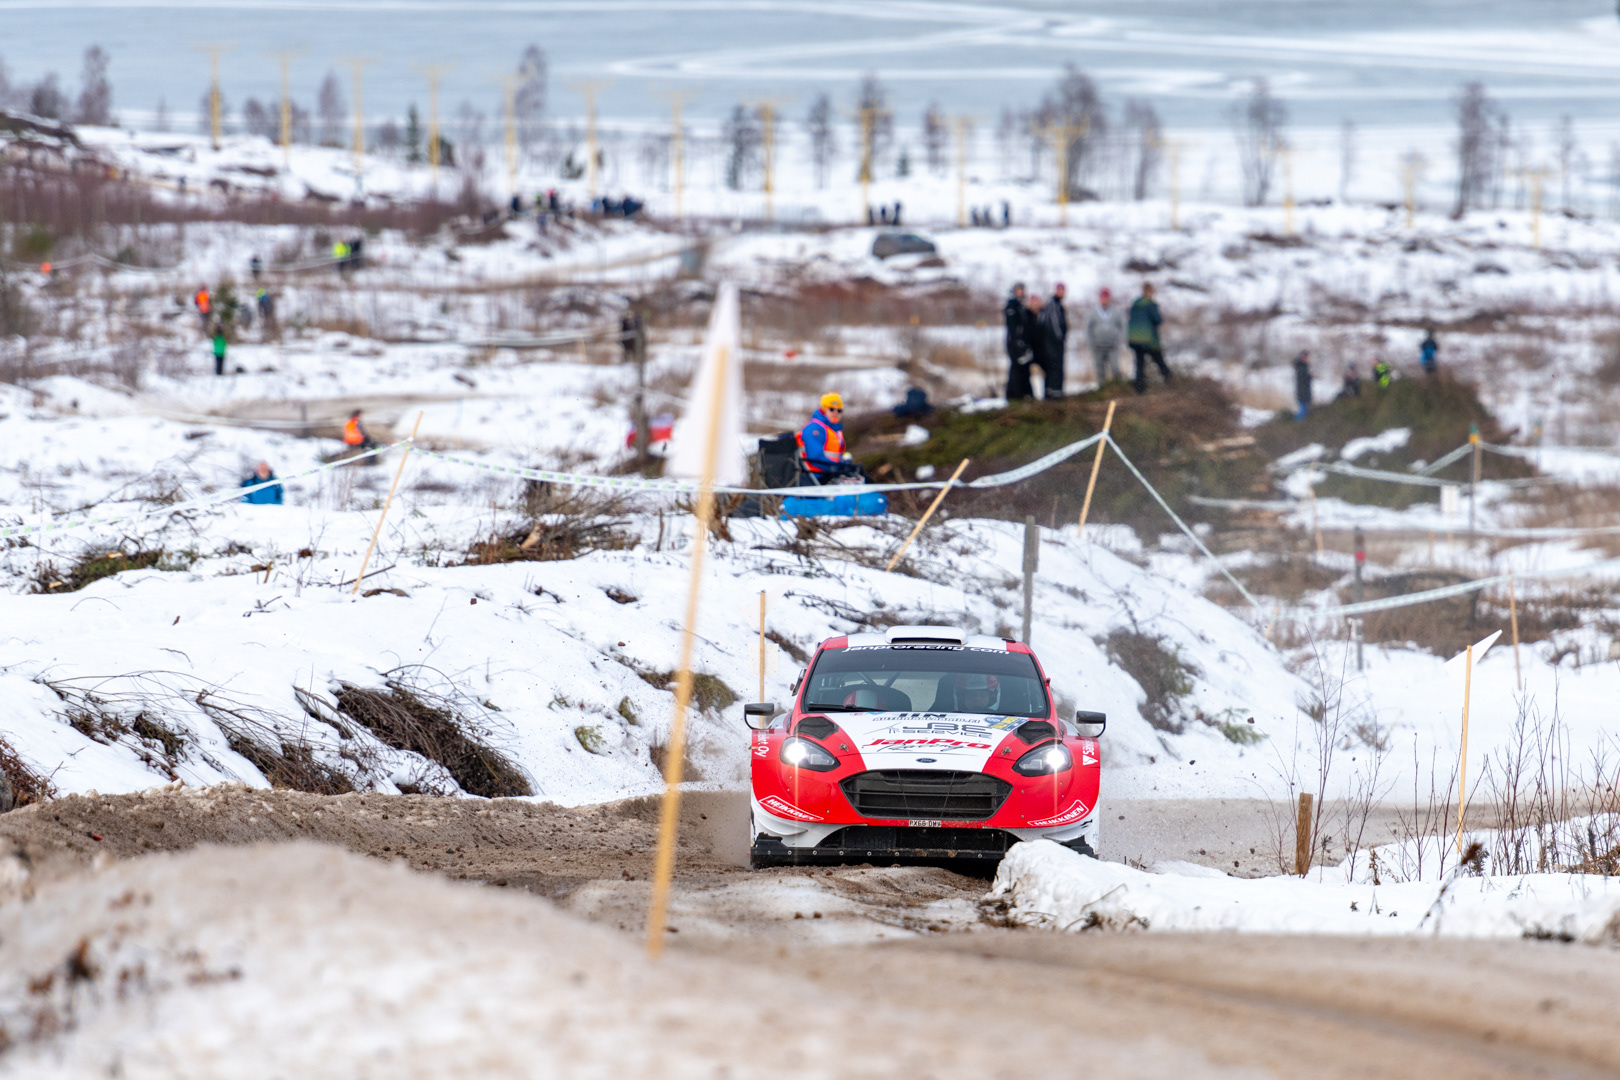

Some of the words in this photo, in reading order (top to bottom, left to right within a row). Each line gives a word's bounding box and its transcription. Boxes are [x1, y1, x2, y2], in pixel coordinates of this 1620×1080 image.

[842, 644, 1010, 655] janproracingcom
[862, 738, 992, 749] JanPro
[1034, 804, 1085, 826] HEIKKINEN
